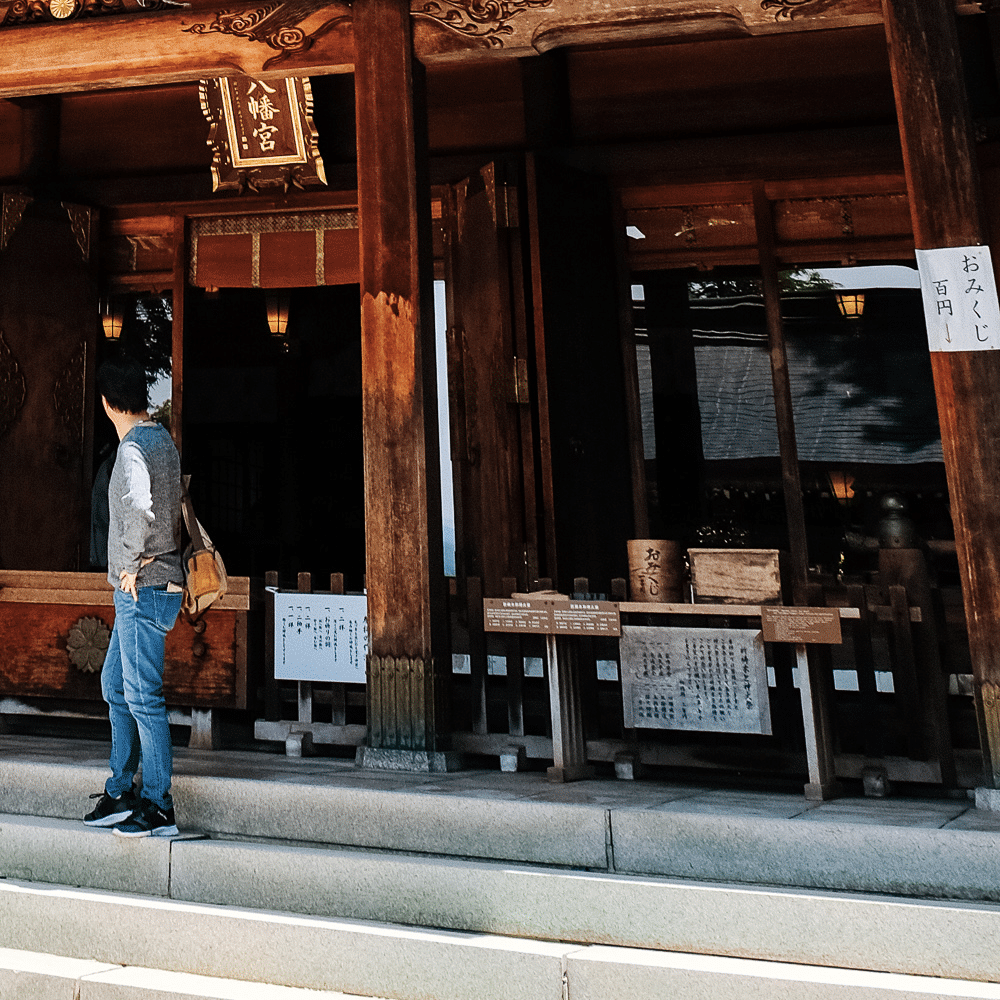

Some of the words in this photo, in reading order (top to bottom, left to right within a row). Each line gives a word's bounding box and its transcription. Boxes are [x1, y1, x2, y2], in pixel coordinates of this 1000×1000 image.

[246, 80, 280, 152] 八幡宮
[932, 279, 953, 316] 百円
[962, 254, 989, 342] おみくじ
[644, 547, 661, 596] おみくじ
